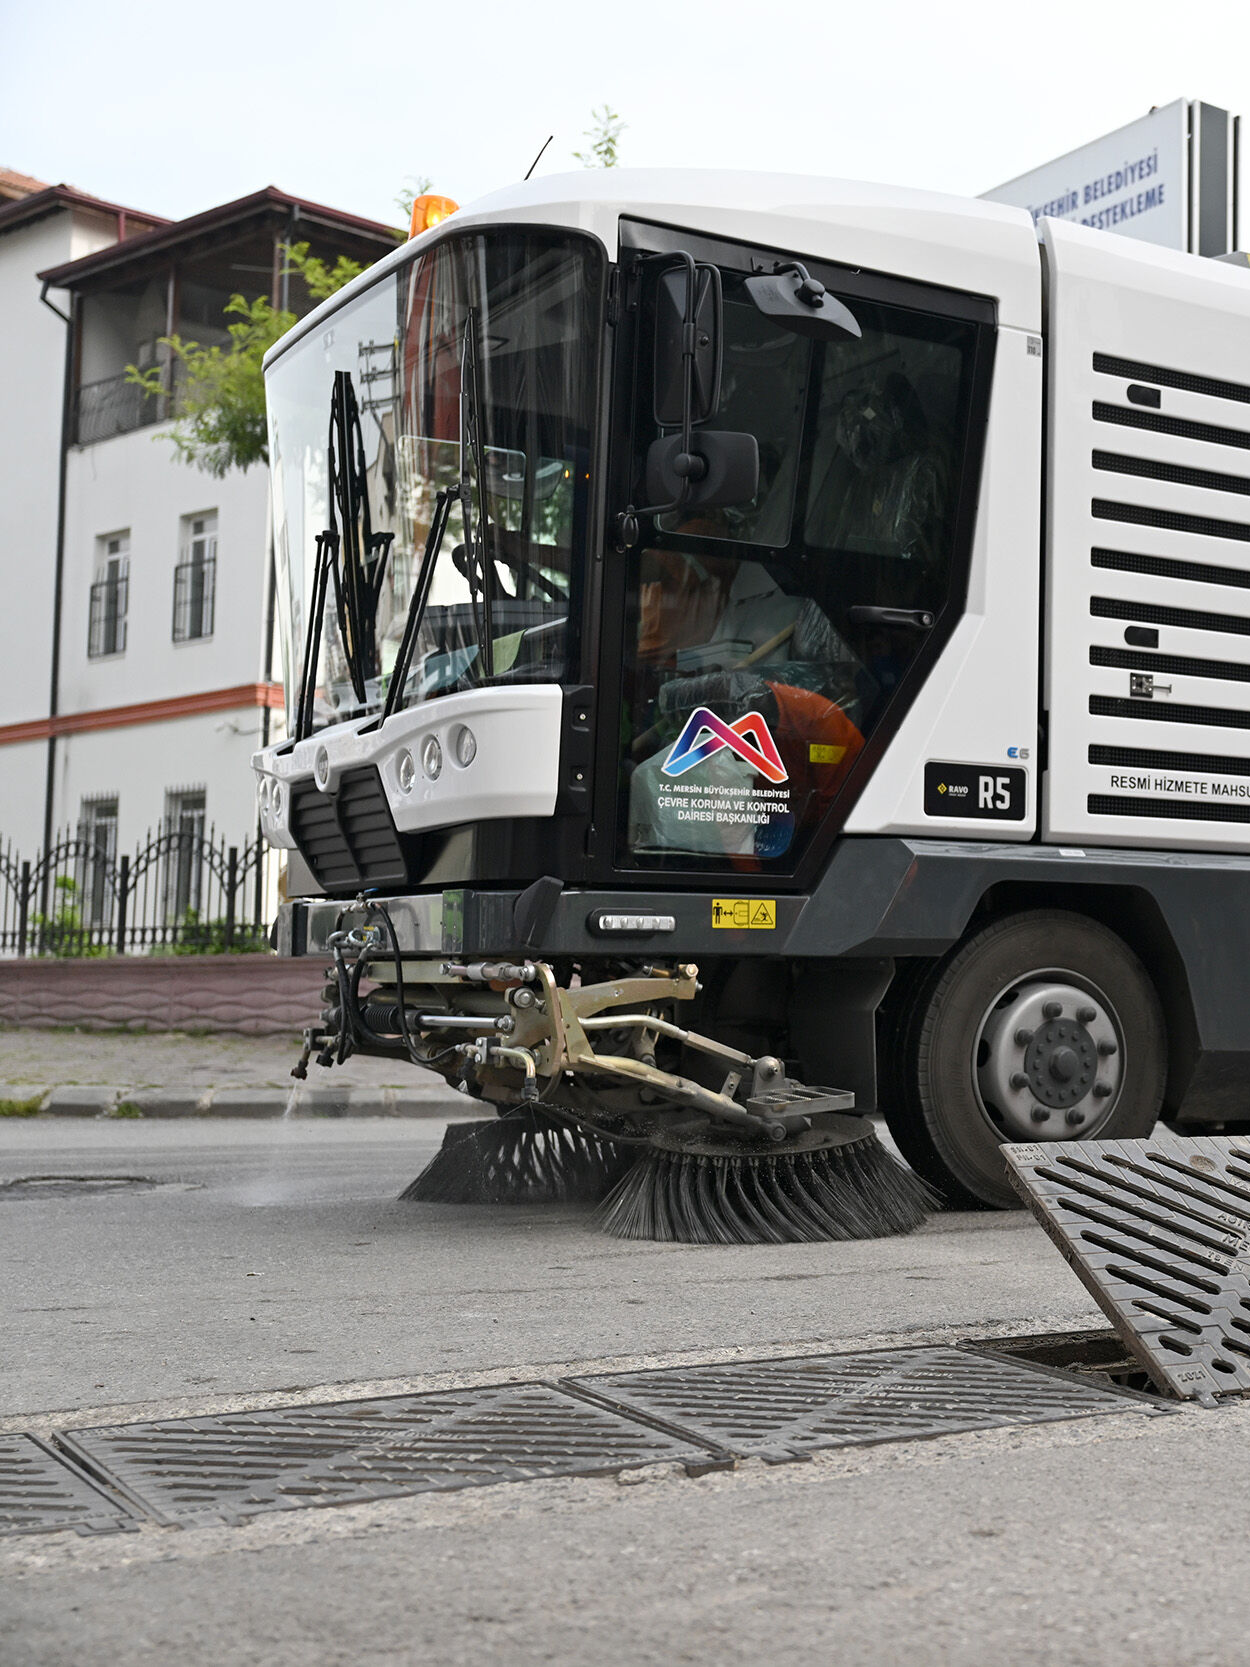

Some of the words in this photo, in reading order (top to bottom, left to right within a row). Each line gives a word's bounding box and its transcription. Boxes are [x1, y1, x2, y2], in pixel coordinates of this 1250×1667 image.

[1084, 147, 1158, 204] BELEDİYESİ
[659, 784, 672, 792] T.C.
[673, 784, 702, 793] MERSİN
[704, 785, 750, 796] BÜYÜKŞEHİR
[752, 788, 790, 799] BELEDİYESİ
[949, 785, 969, 794] RAVO
[978, 775, 1011, 810] R5
[1110, 774, 1151, 791] RESMİ
[1155, 776, 1208, 795] HİZMETE
[658, 797, 689, 809] ÇEVRE
[691, 798, 732, 810] KORUMA
[734, 801, 746, 811] VE
[747, 801, 790, 813] KONTROL
[677, 809, 714, 822] DAİRESİ
[716, 812, 770, 825] BAŞKANLIĞI
